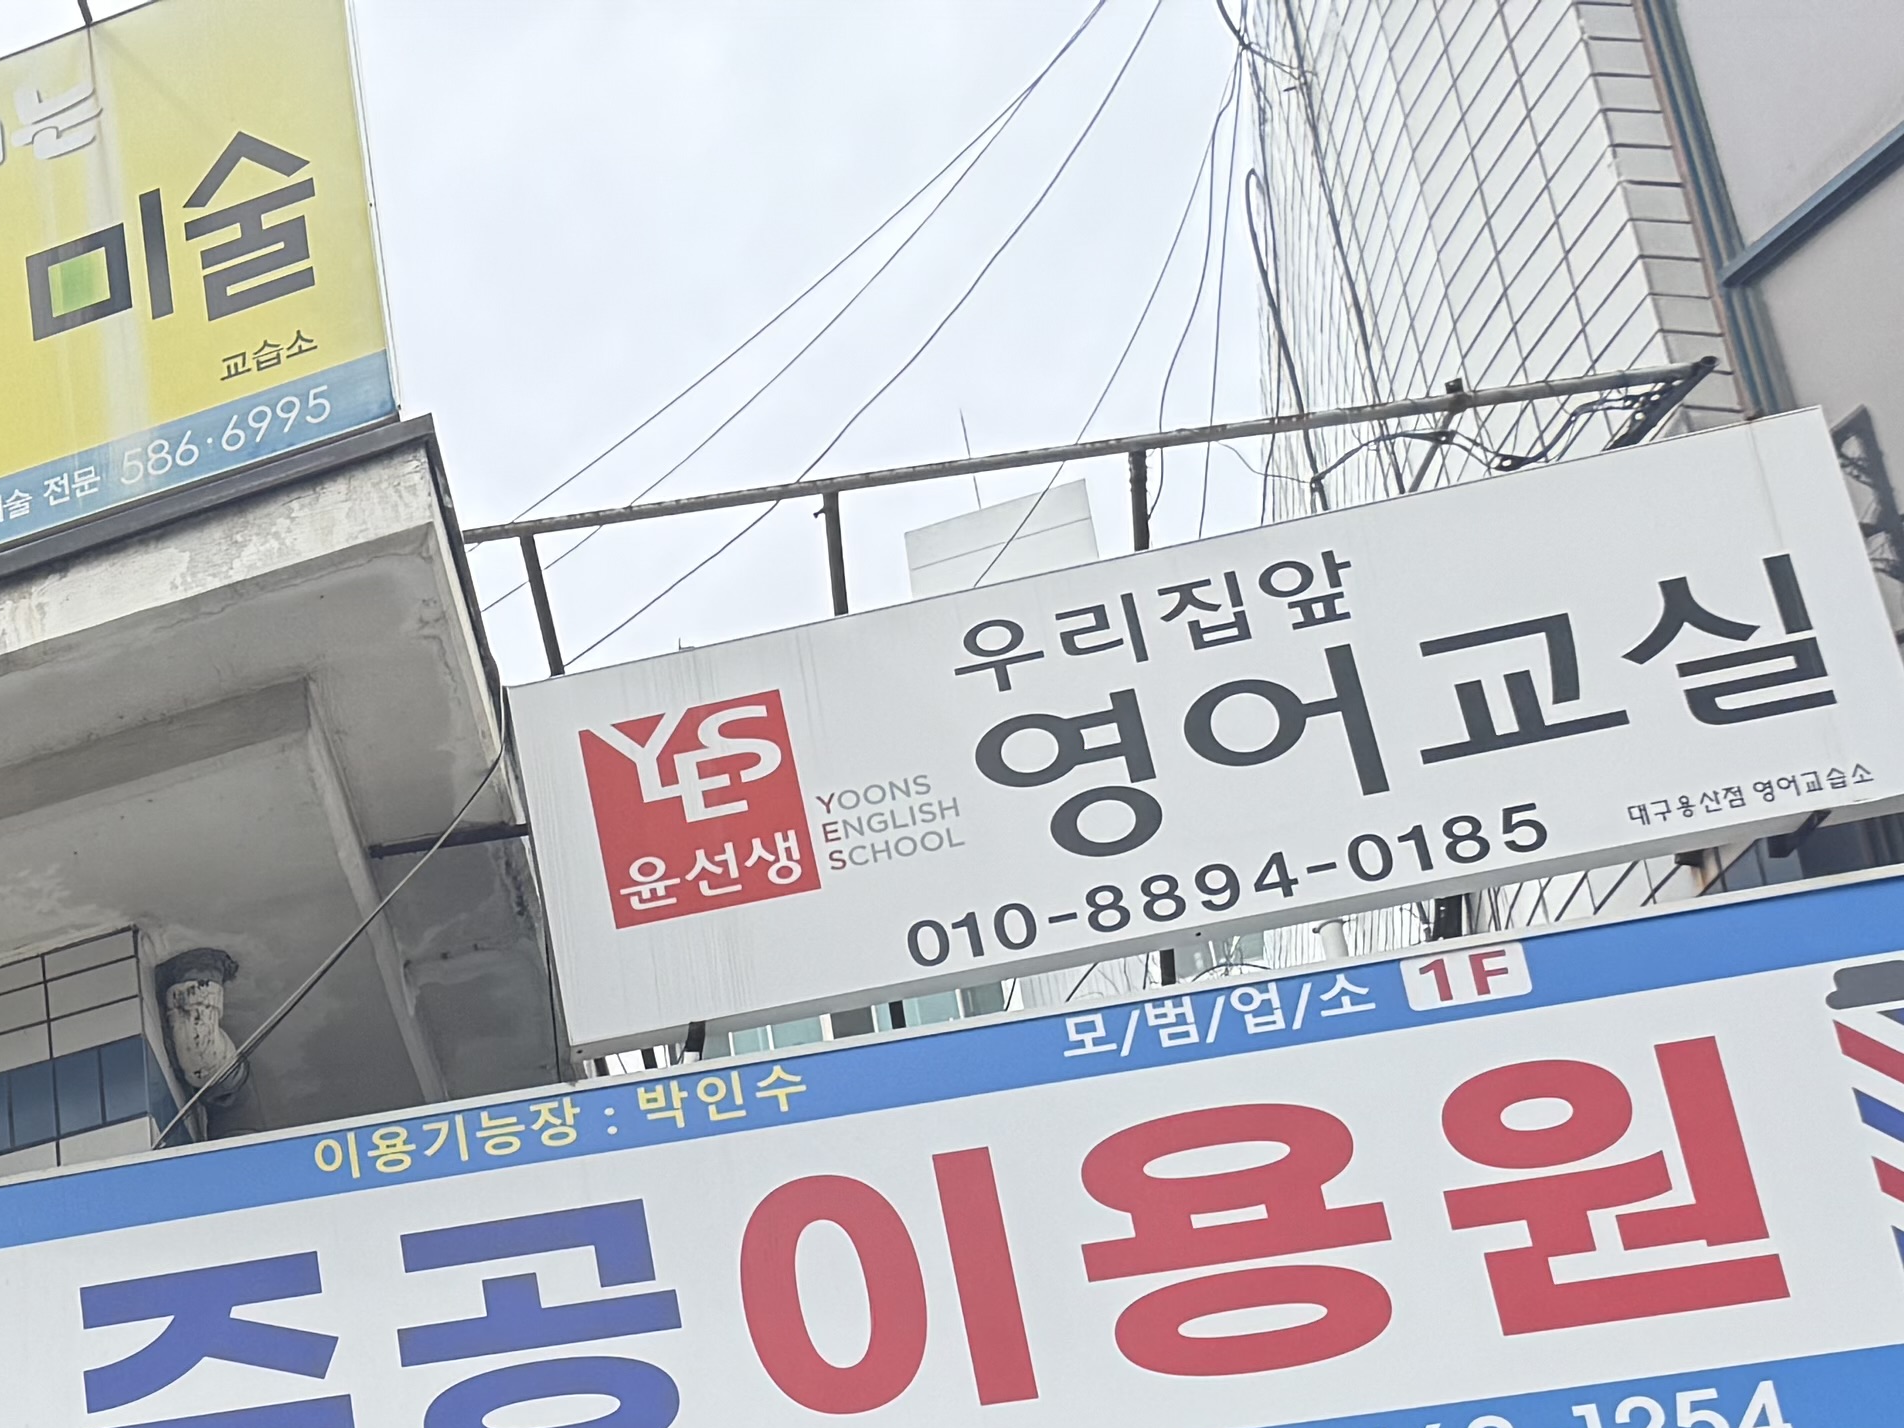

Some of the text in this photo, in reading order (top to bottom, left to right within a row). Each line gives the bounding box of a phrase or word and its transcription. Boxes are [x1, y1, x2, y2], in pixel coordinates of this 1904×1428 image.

[23, 129, 318, 342] 미술
[218, 329, 318, 382] 교습소
[42, 468, 101, 505] 전문
[952, 549, 1355, 693] 우리집앞
[974, 551, 1840, 858] 영어교실
[815, 774, 933, 818] YOONS
[1752, 761, 1874, 806] 영어교습소
[821, 797, 963, 844] ENGLISH
[619, 828, 804, 913] 윤선생
[826, 830, 966, 873] SCHOOL
[906, 803, 1551, 970] 010-8894-0185
[1417, 946, 1518, 1002] 1F
[312, 1064, 810, 1180] 이용기능장 박인수
